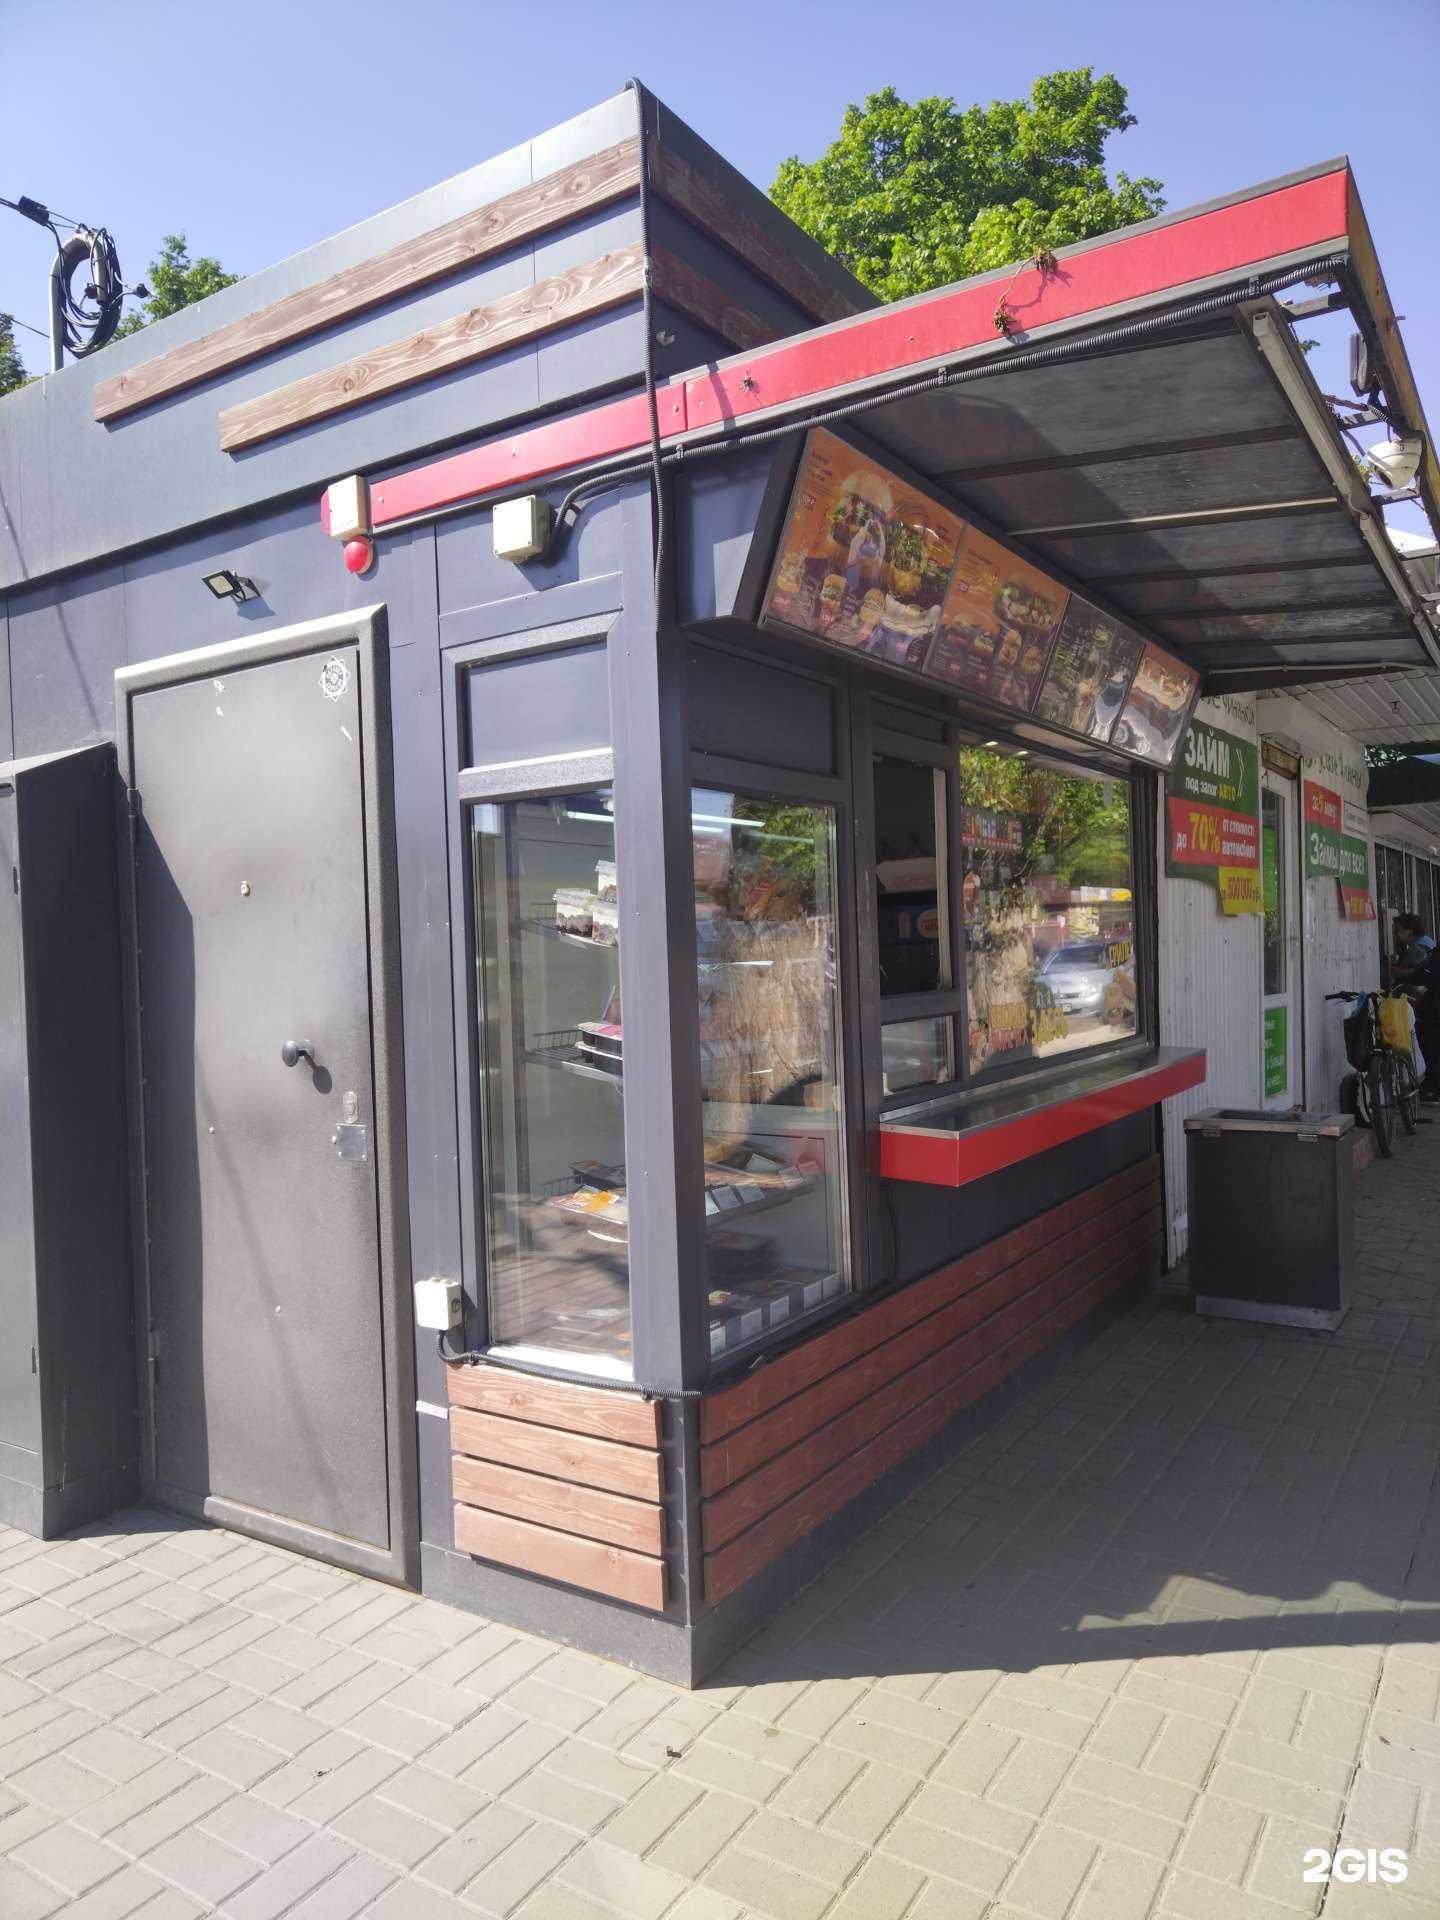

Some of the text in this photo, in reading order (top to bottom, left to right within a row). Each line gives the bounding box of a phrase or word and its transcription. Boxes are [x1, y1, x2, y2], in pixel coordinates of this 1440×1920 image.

[1184, 727, 1230, 779] ЗАЙМ
[1185, 776, 1236, 802] под залог АВТО
[1176, 812, 1220, 855] до 70%
[1222, 818, 1230, 832] от
